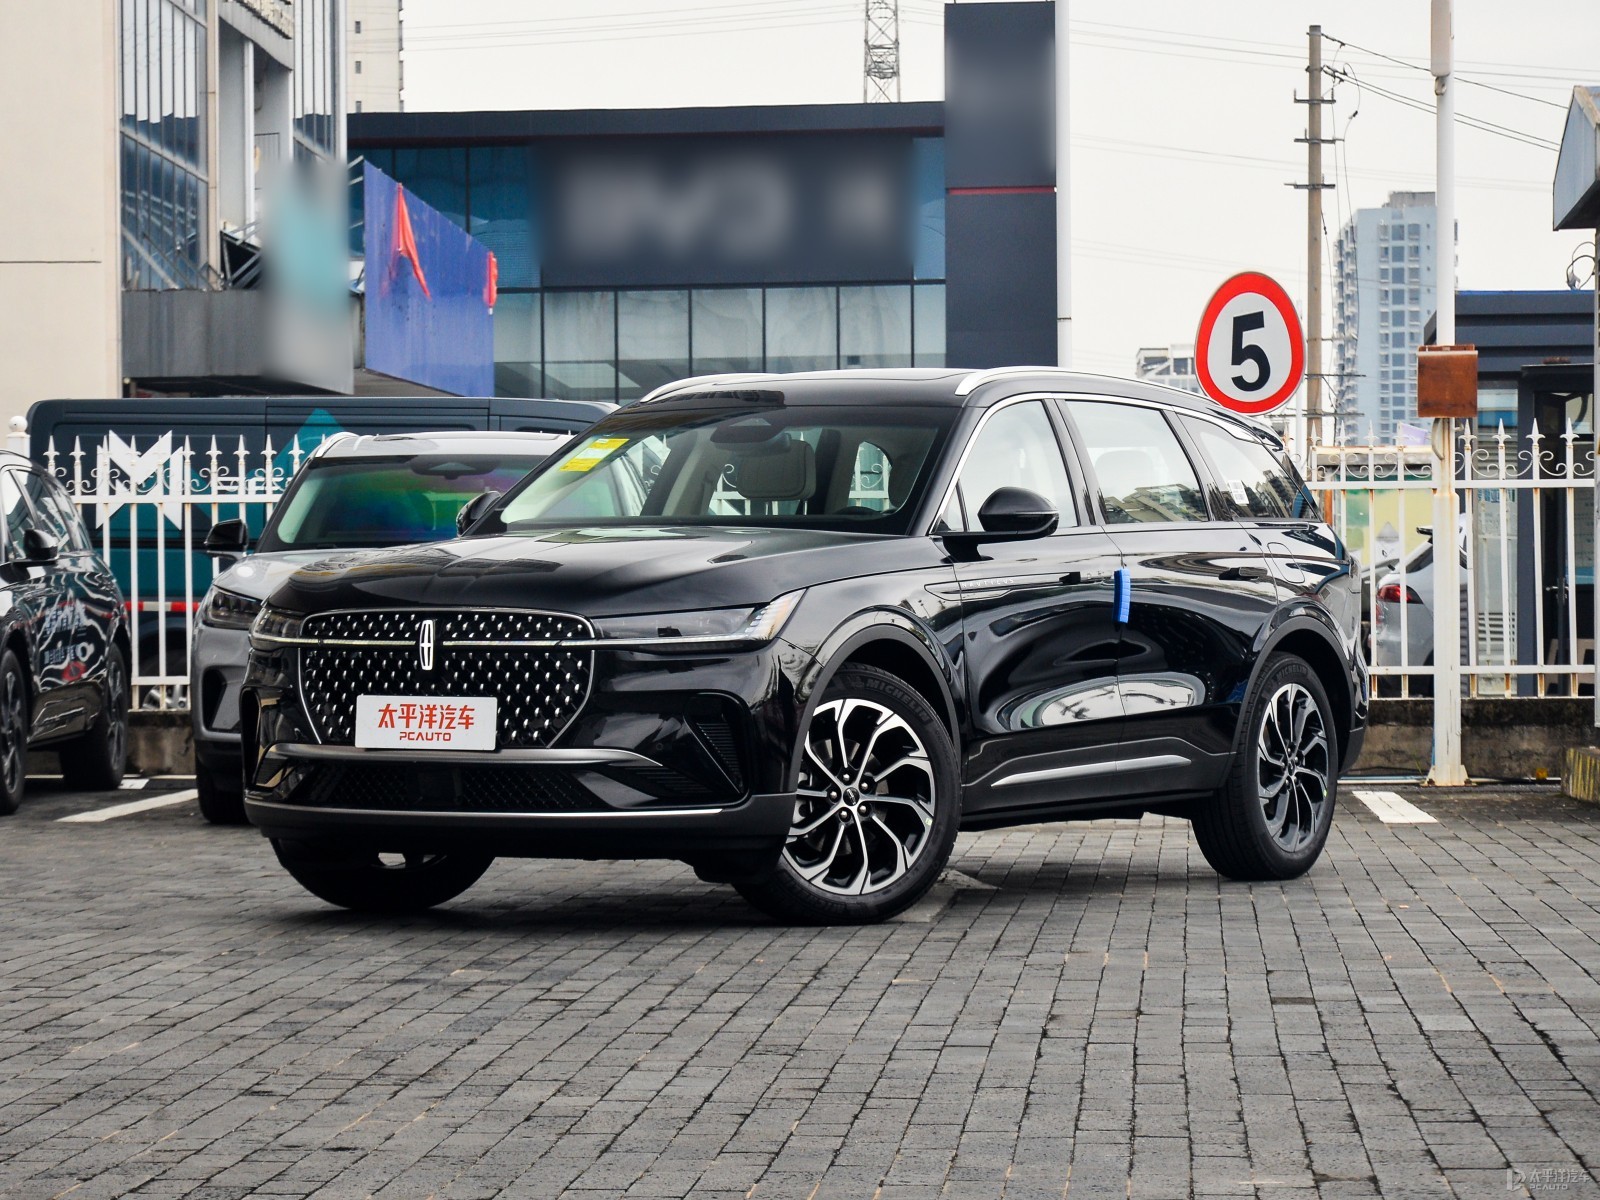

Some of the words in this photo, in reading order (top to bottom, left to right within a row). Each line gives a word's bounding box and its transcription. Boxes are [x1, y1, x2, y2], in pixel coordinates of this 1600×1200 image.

[1231, 311, 1271, 392] 5
[378, 703, 475, 730] 太平洋汽车
[866, 679, 931, 722] MICHELIN
[400, 732, 452, 741] PCAUTO
